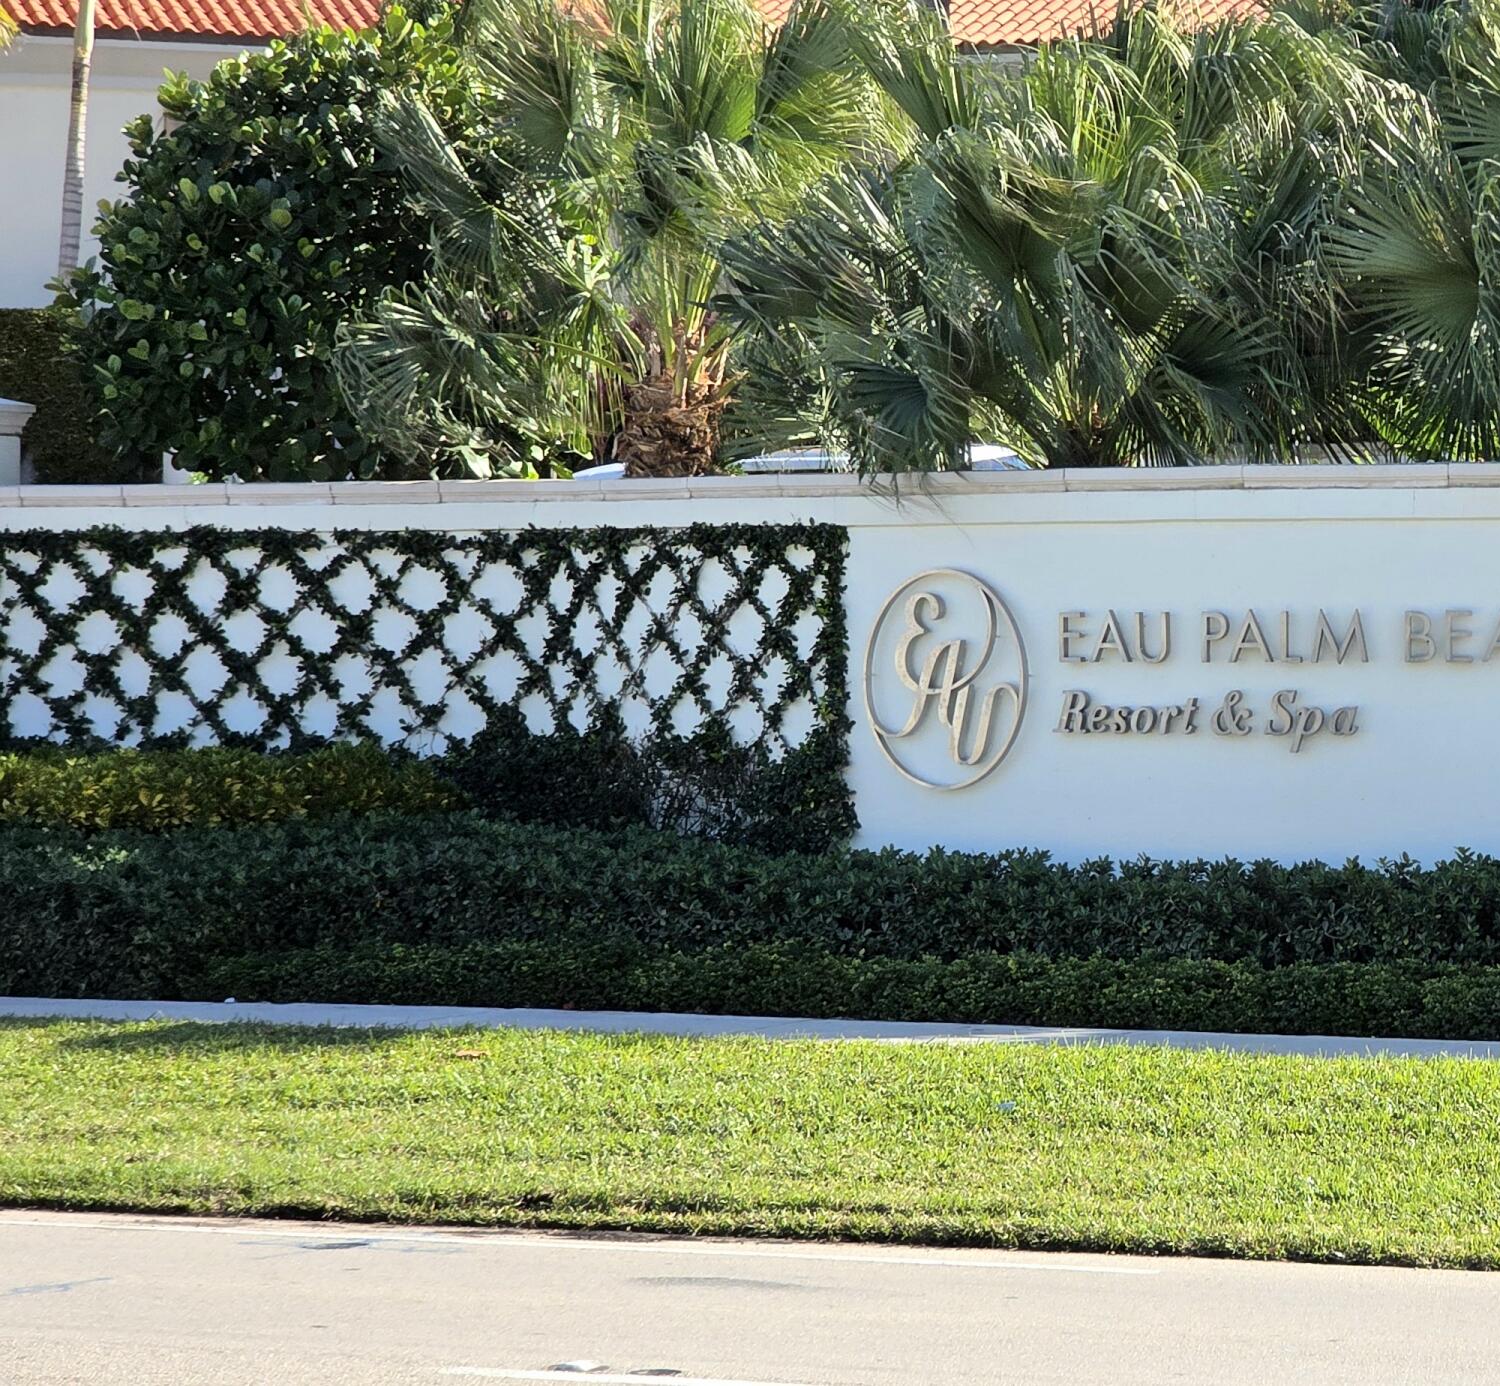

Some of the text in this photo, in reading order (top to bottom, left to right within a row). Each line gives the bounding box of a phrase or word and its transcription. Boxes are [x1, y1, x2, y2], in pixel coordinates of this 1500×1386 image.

[1058, 608, 1172, 664] EAU
[1201, 608, 1369, 664] PALM
[1052, 689, 1360, 753] Resort & Spa
